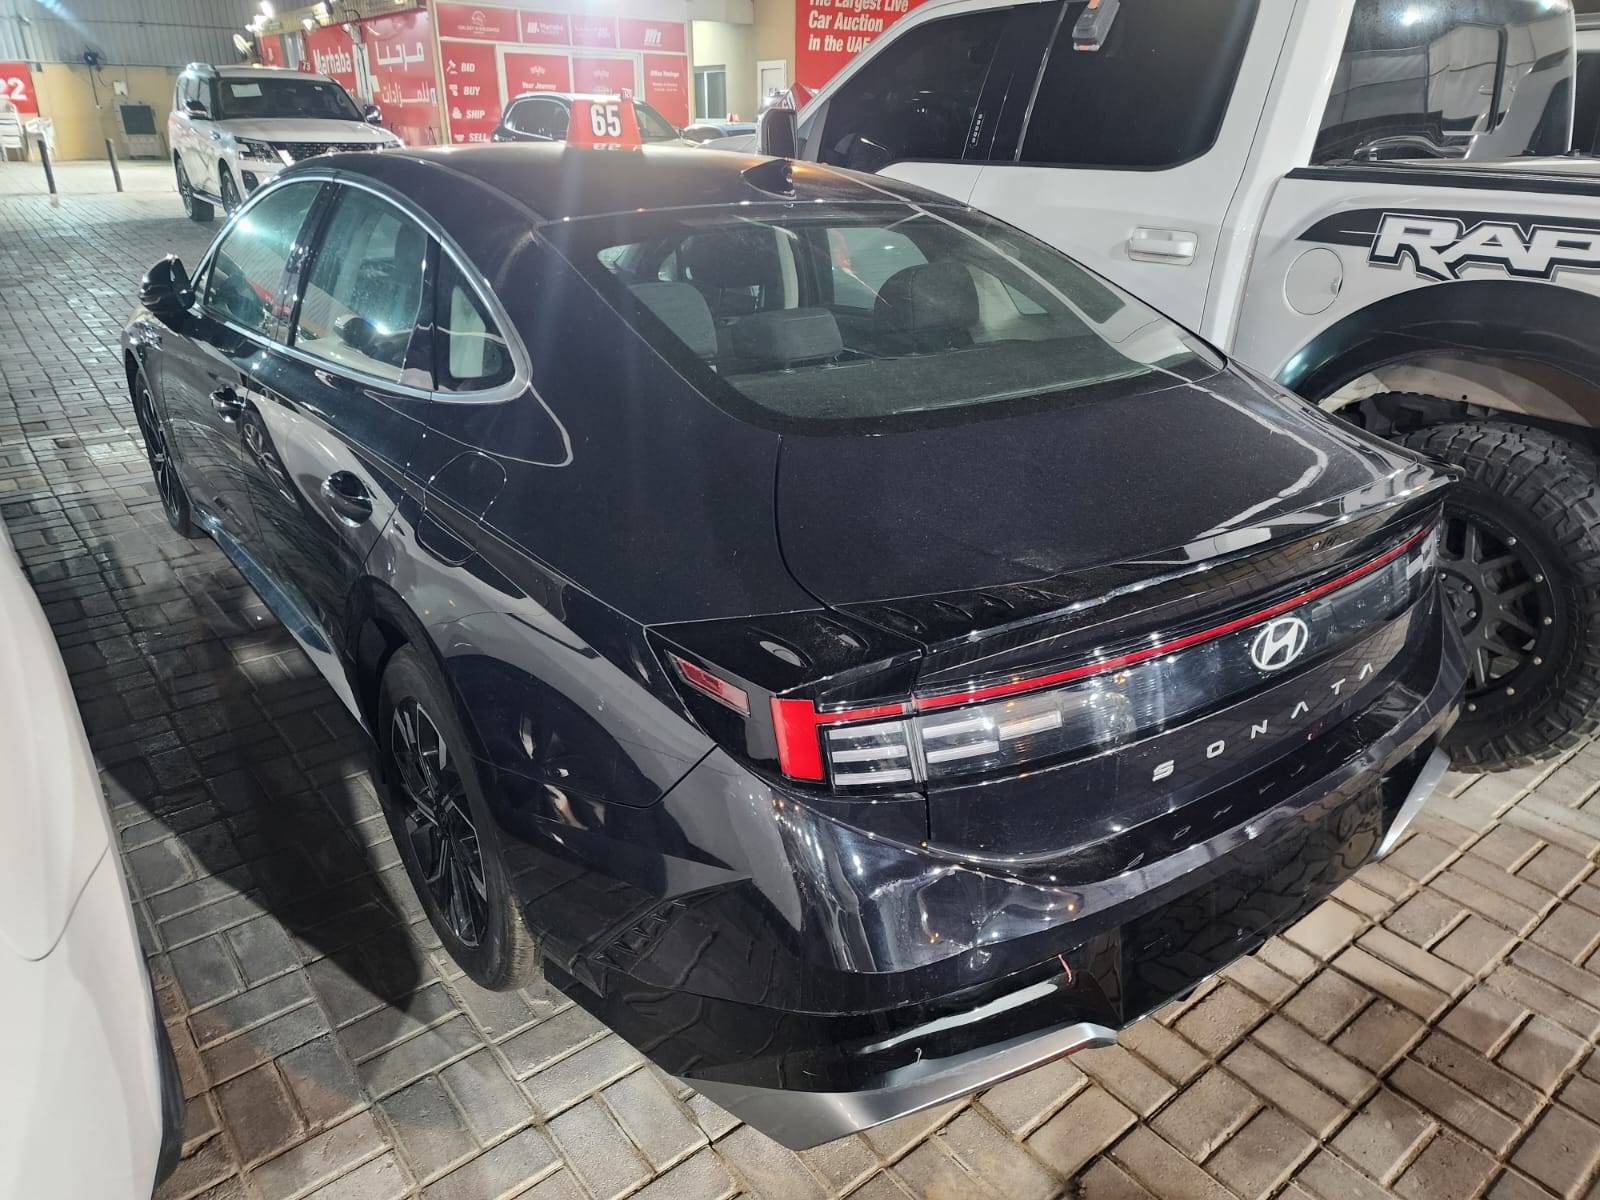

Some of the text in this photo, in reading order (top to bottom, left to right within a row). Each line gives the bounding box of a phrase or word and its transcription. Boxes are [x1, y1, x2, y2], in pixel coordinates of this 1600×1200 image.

[808, 10, 884, 33] Car Auction
[808, 33, 821, 51] in
[824, 35, 844, 52] the
[313, 46, 352, 74] Marhaba
[375, 41, 424, 72] مرحبا
[461, 62, 476, 73] BID
[463, 86, 480, 96] BUY
[466, 109, 486, 120] SHIP
[590, 104, 622, 137] 65
[469, 133, 488, 143] SELL
[1152, 663, 1374, 782] SONATA
